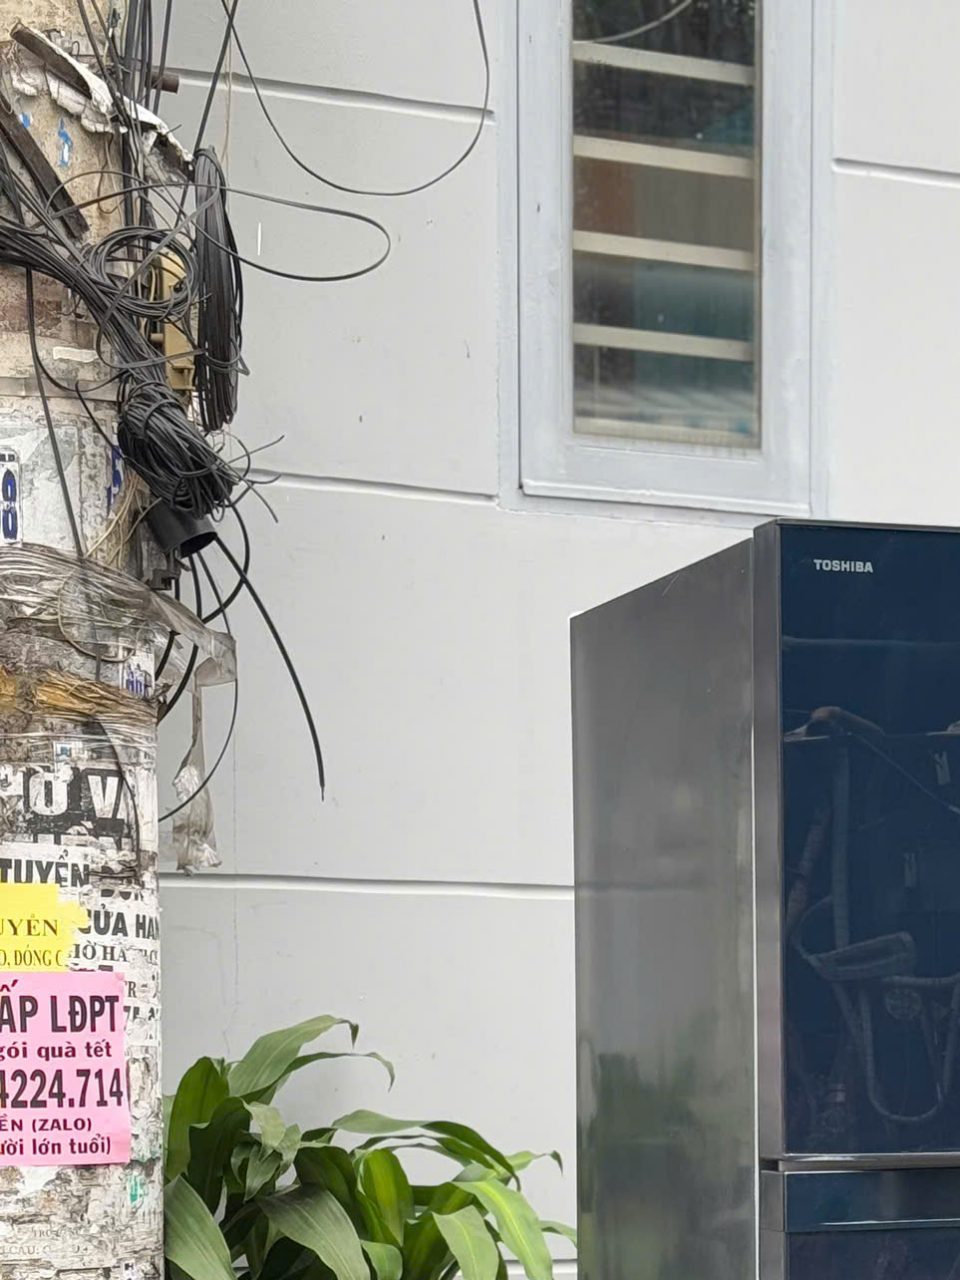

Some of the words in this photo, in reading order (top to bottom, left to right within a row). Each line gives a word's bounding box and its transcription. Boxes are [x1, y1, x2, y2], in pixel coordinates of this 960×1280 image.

[813, 559, 873, 573] TOSHIBA
[50, 995, 120, 1033] LĐPT
[37, 1041, 76, 1061] quà
[84, 1039, 112, 1058] tết
[32, 1117, 92, 1133] (ZALO)
[32, 1137, 62, 1156] lớn
[69, 1133, 111, 1155] tuổi)
